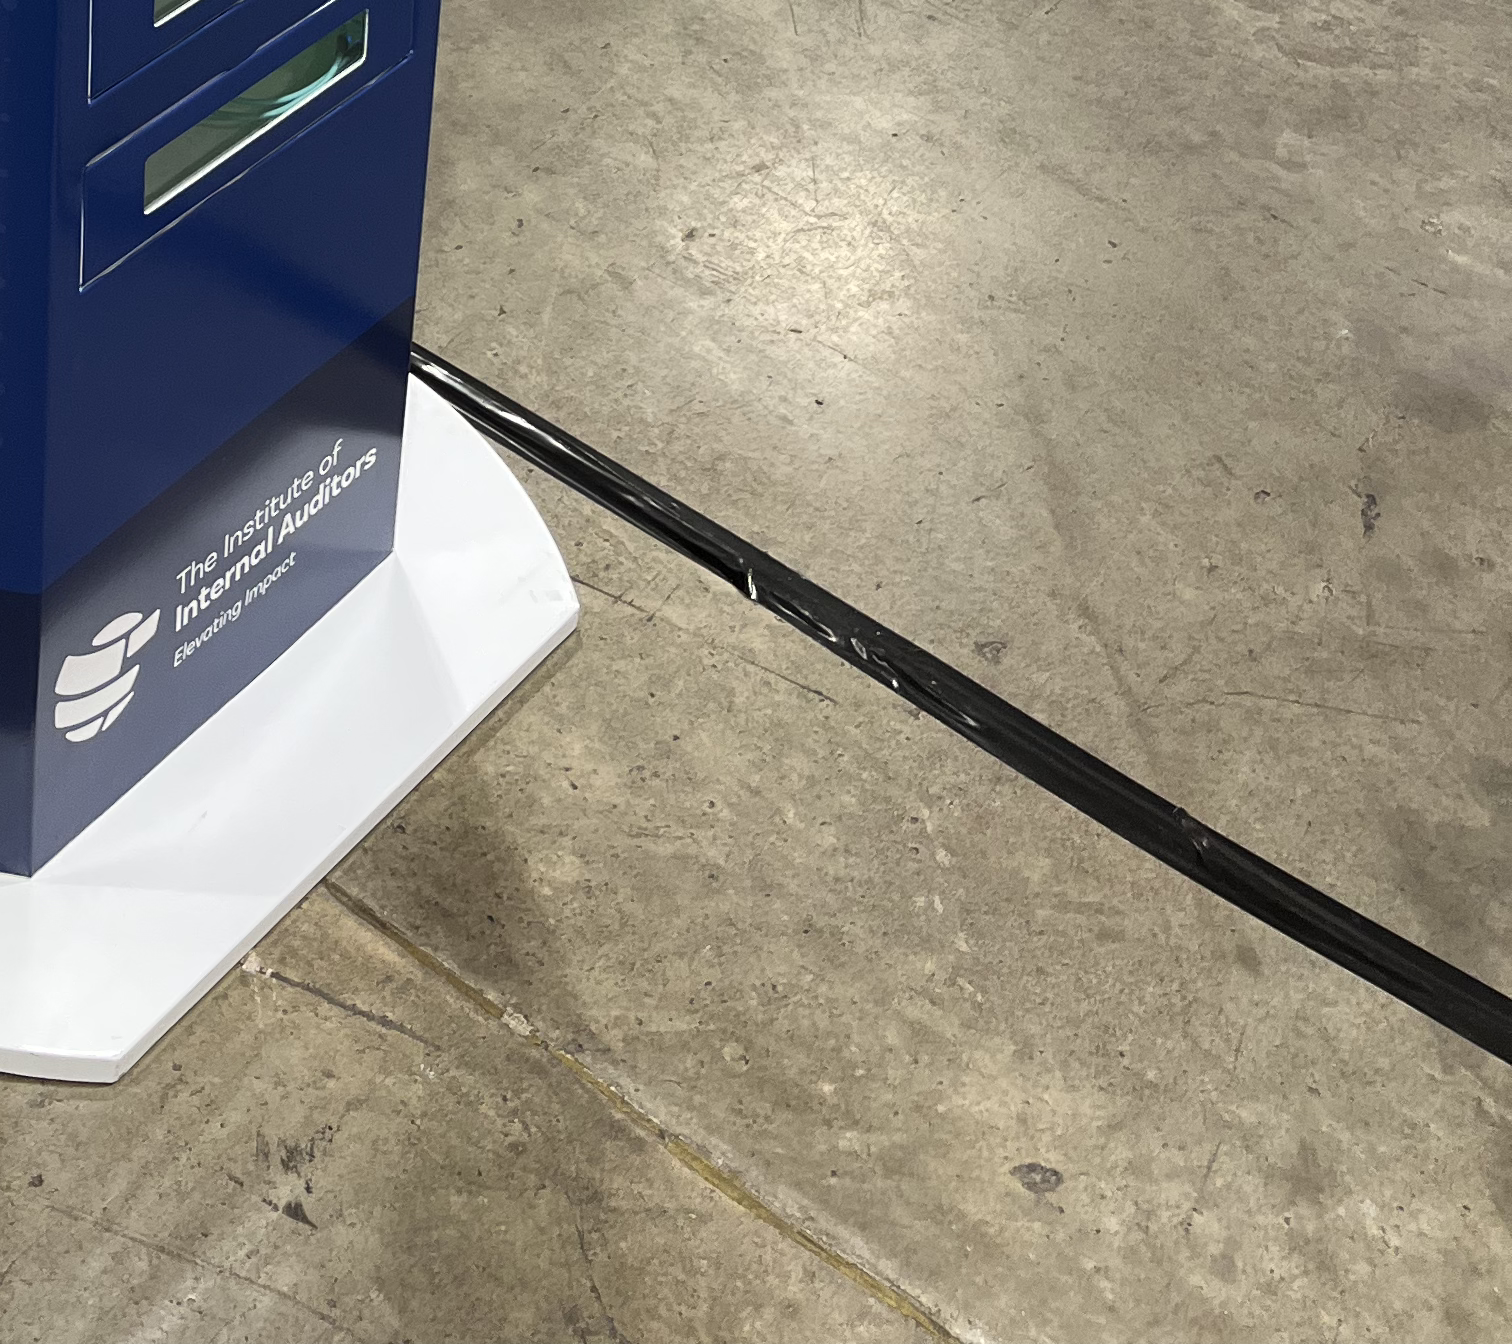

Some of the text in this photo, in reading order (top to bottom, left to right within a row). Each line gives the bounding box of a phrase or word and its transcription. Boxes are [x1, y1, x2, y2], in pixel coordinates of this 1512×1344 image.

[175, 447, 377, 632] Internal Auditors
[176, 438, 343, 593] The Institute of
[173, 551, 297, 667] Elevating Impact
